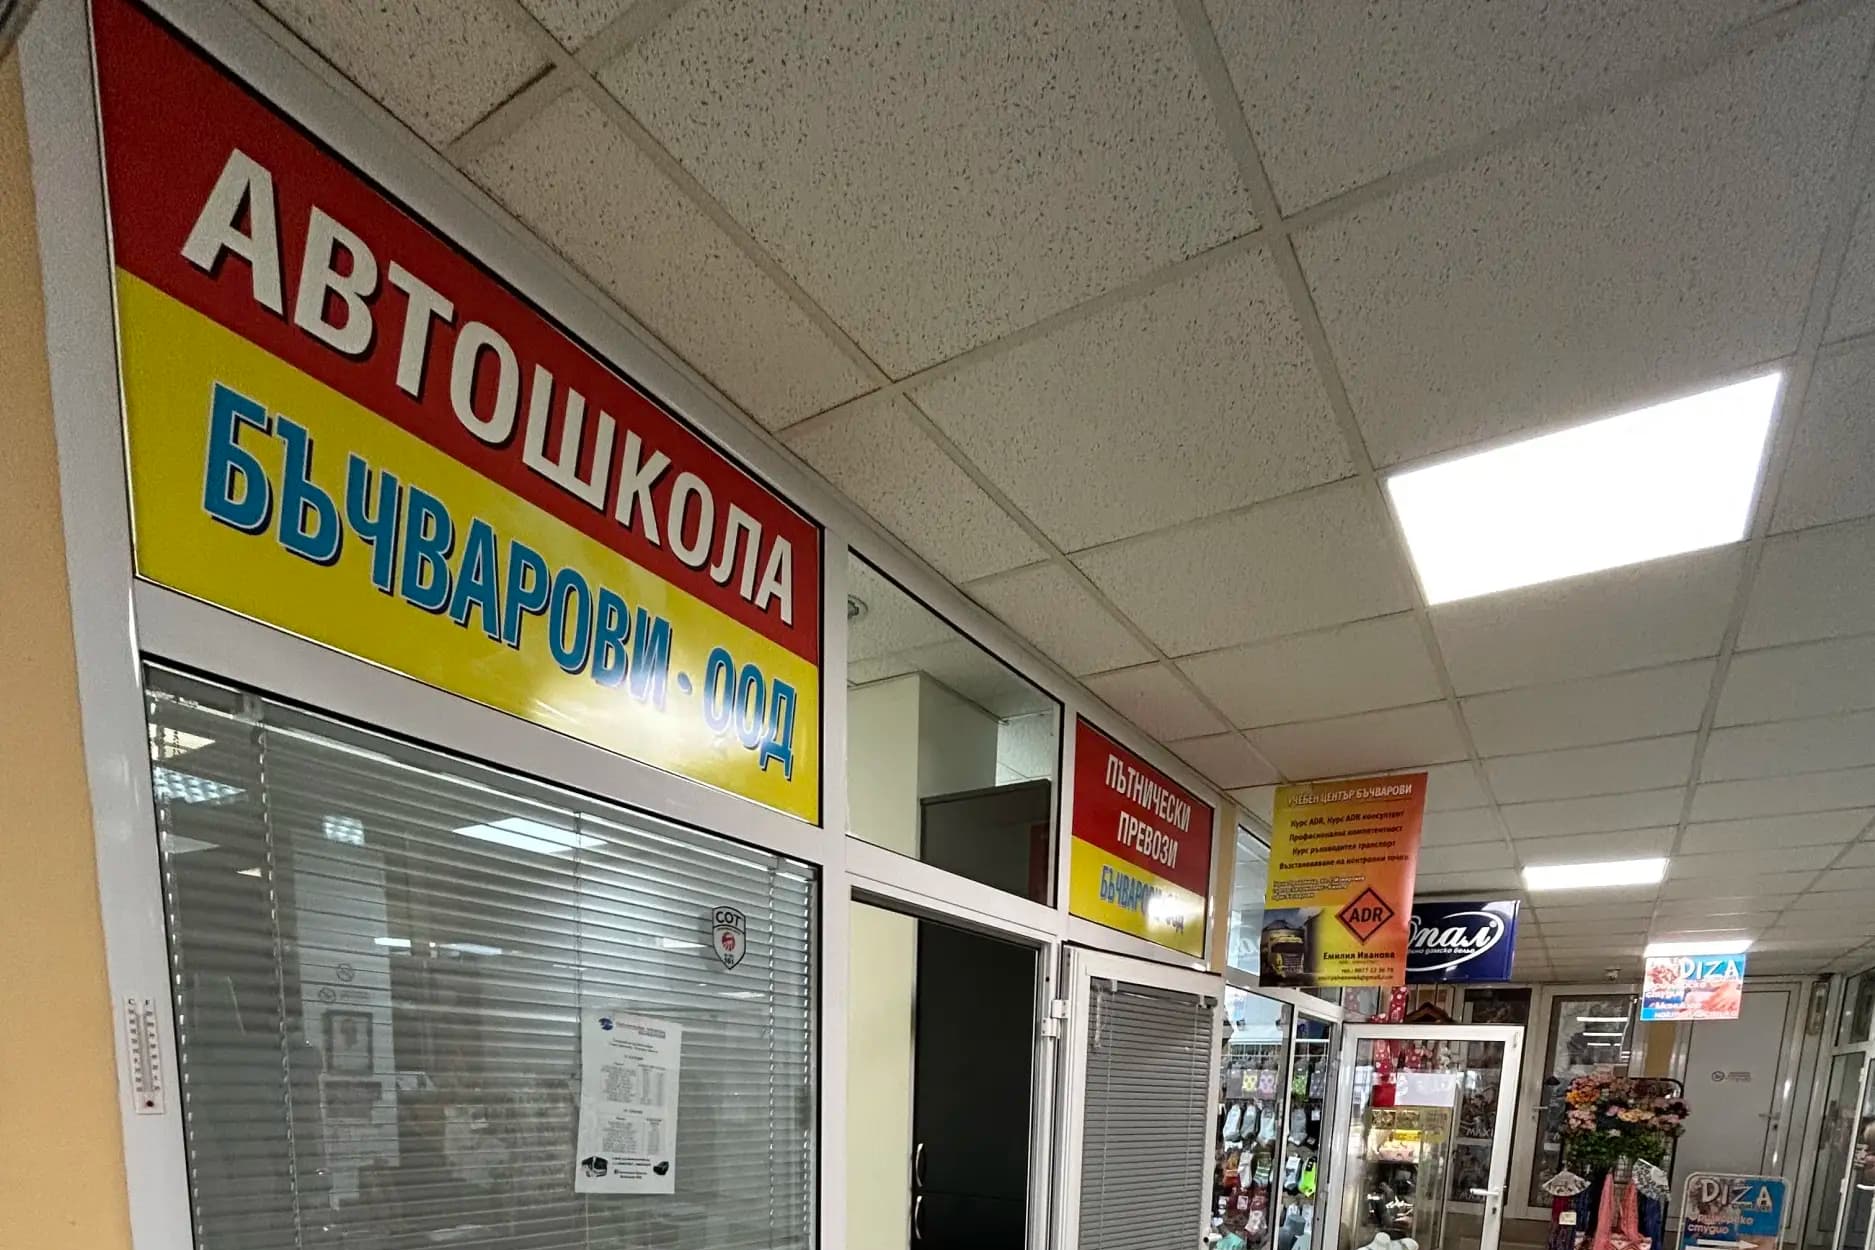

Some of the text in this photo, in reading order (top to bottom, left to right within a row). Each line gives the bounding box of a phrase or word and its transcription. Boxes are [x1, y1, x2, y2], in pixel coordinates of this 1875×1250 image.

[181, 148, 795, 627] АВТОШКОЛА
[1105, 753, 1191, 833] ПЪТНИЧЕСКИ
[1322, 790, 1354, 804] ЦЕНТЪР
[1356, 784, 1412, 799] БЪЧВАРОВИ
[1117, 811, 1179, 869] ПРЕВОЗИ
[1349, 907, 1384, 923] ADR
[1323, 951, 1396, 960] Емилия Иванова
[1680, 957, 1741, 980] DIZA
[1701, 1179, 1773, 1213] DIZA
